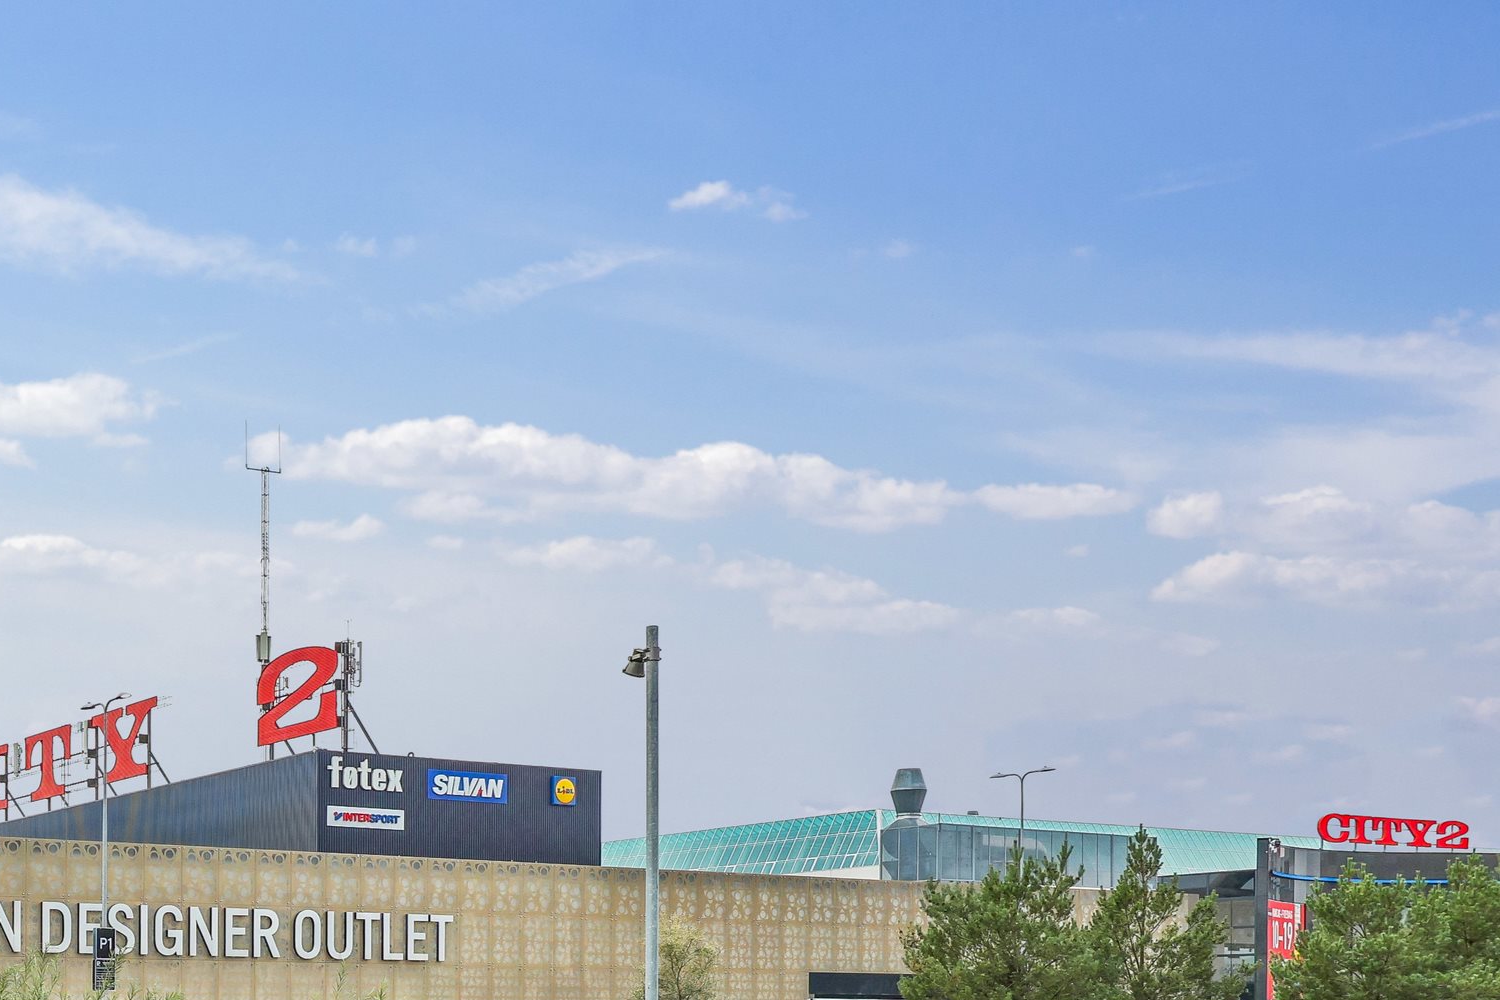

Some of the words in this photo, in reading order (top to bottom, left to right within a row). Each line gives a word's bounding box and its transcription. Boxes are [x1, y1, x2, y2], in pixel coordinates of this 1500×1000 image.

[256, 645, 338, 747] 2
[327, 755, 403, 793] føtex
[432, 774, 504, 799] SILVAN
[342, 811, 400, 825] INTERSPORT
[1317, 812, 1469, 849] CITY2
[40, 900, 281, 959] DESIGNER
[294, 909, 454, 962] OUTLET
[100, 937, 112, 951] P1
